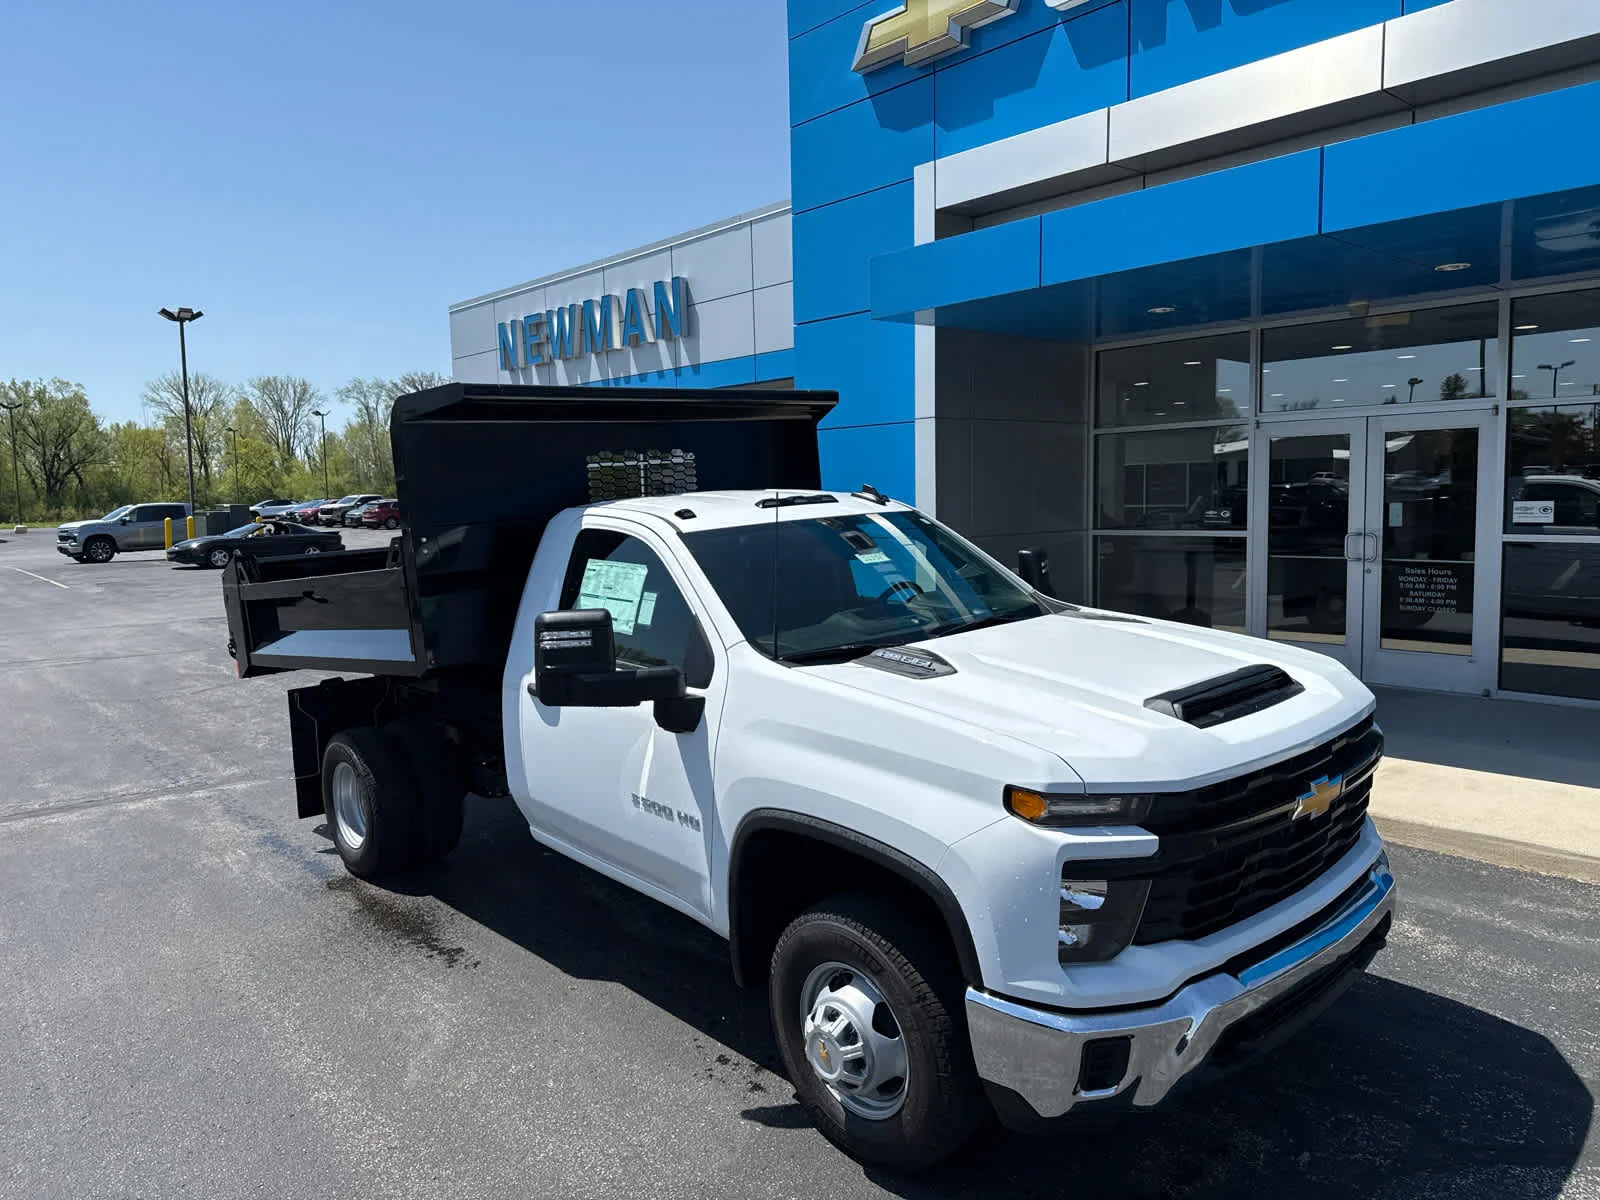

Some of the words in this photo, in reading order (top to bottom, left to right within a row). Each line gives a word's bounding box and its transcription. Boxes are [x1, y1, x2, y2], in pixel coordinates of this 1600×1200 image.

[497, 276, 690, 371] NEWMAN
[1428, 567, 1452, 576] Hours
[1398, 575, 1427, 583] MONDAY
[1409, 590, 1446, 598] SATURDAY
